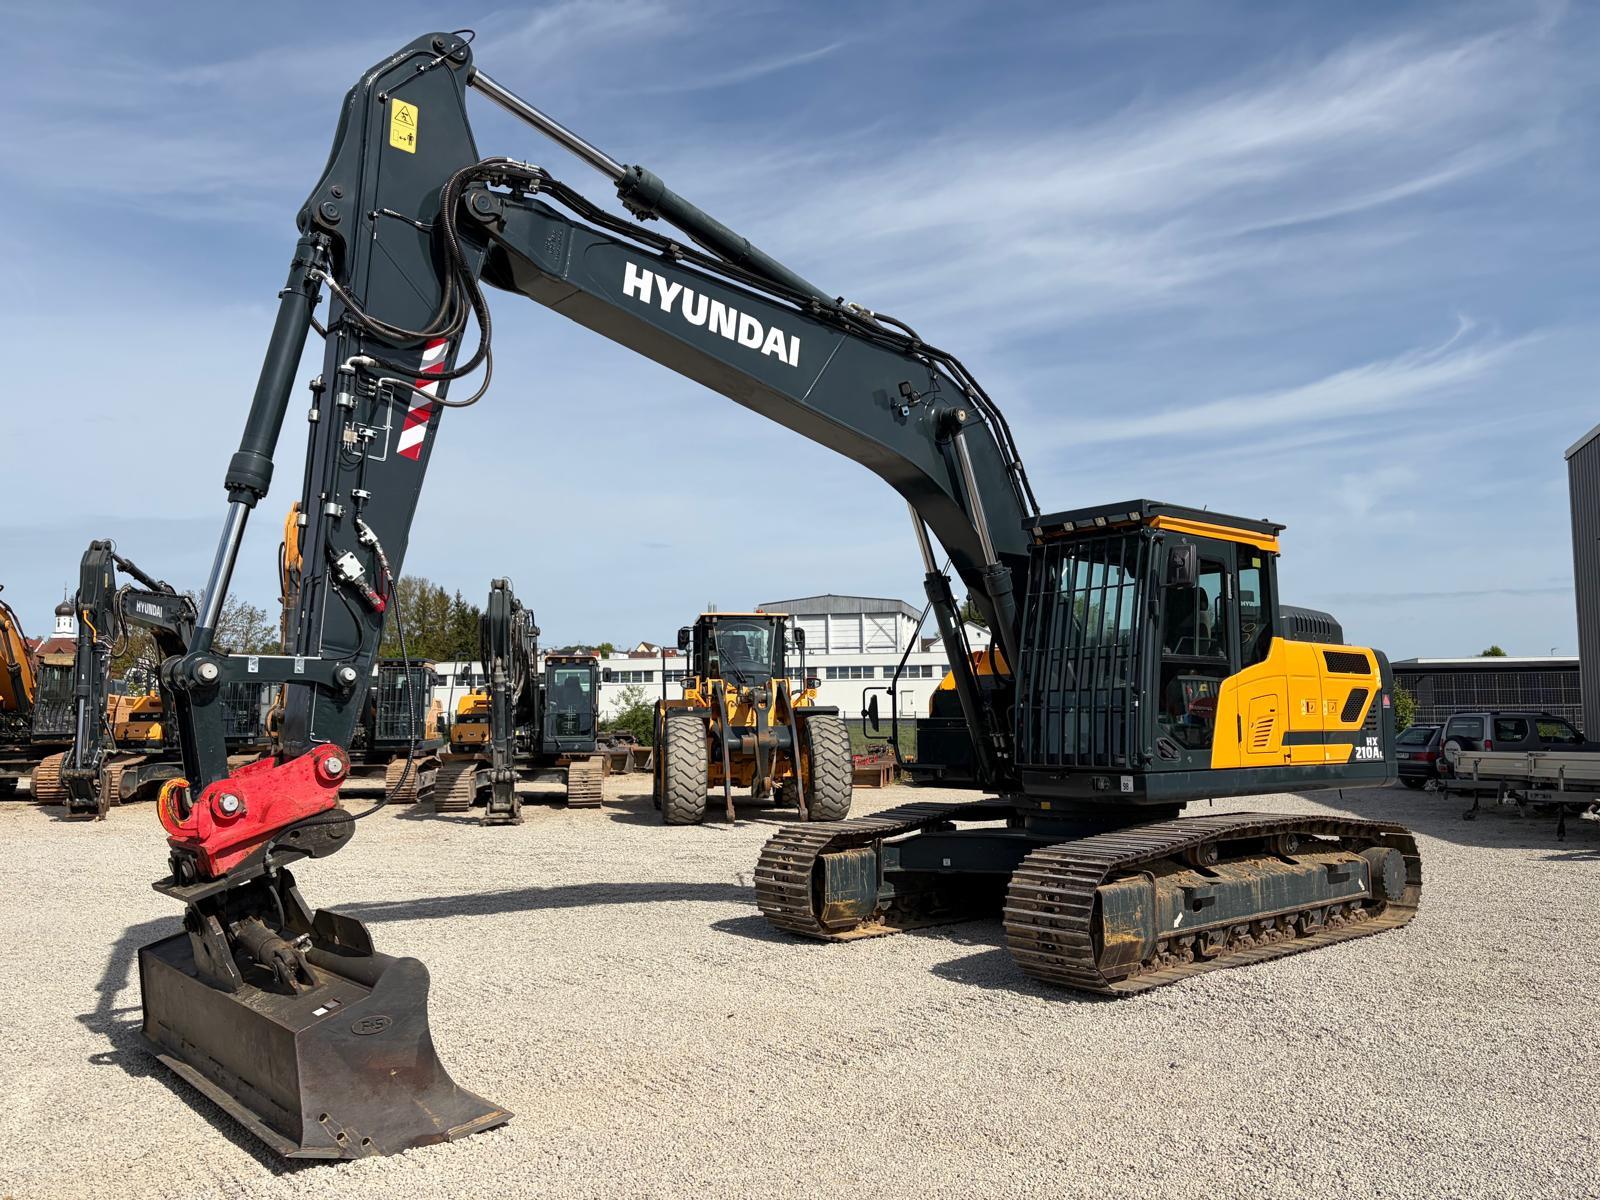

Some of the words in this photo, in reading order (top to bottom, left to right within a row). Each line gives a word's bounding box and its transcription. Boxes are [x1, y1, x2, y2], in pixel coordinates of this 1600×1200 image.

[622, 261, 801, 368] HYUNDAI
[136, 600, 163, 618] HYUNDAI
[1366, 737, 1378, 746] HX
